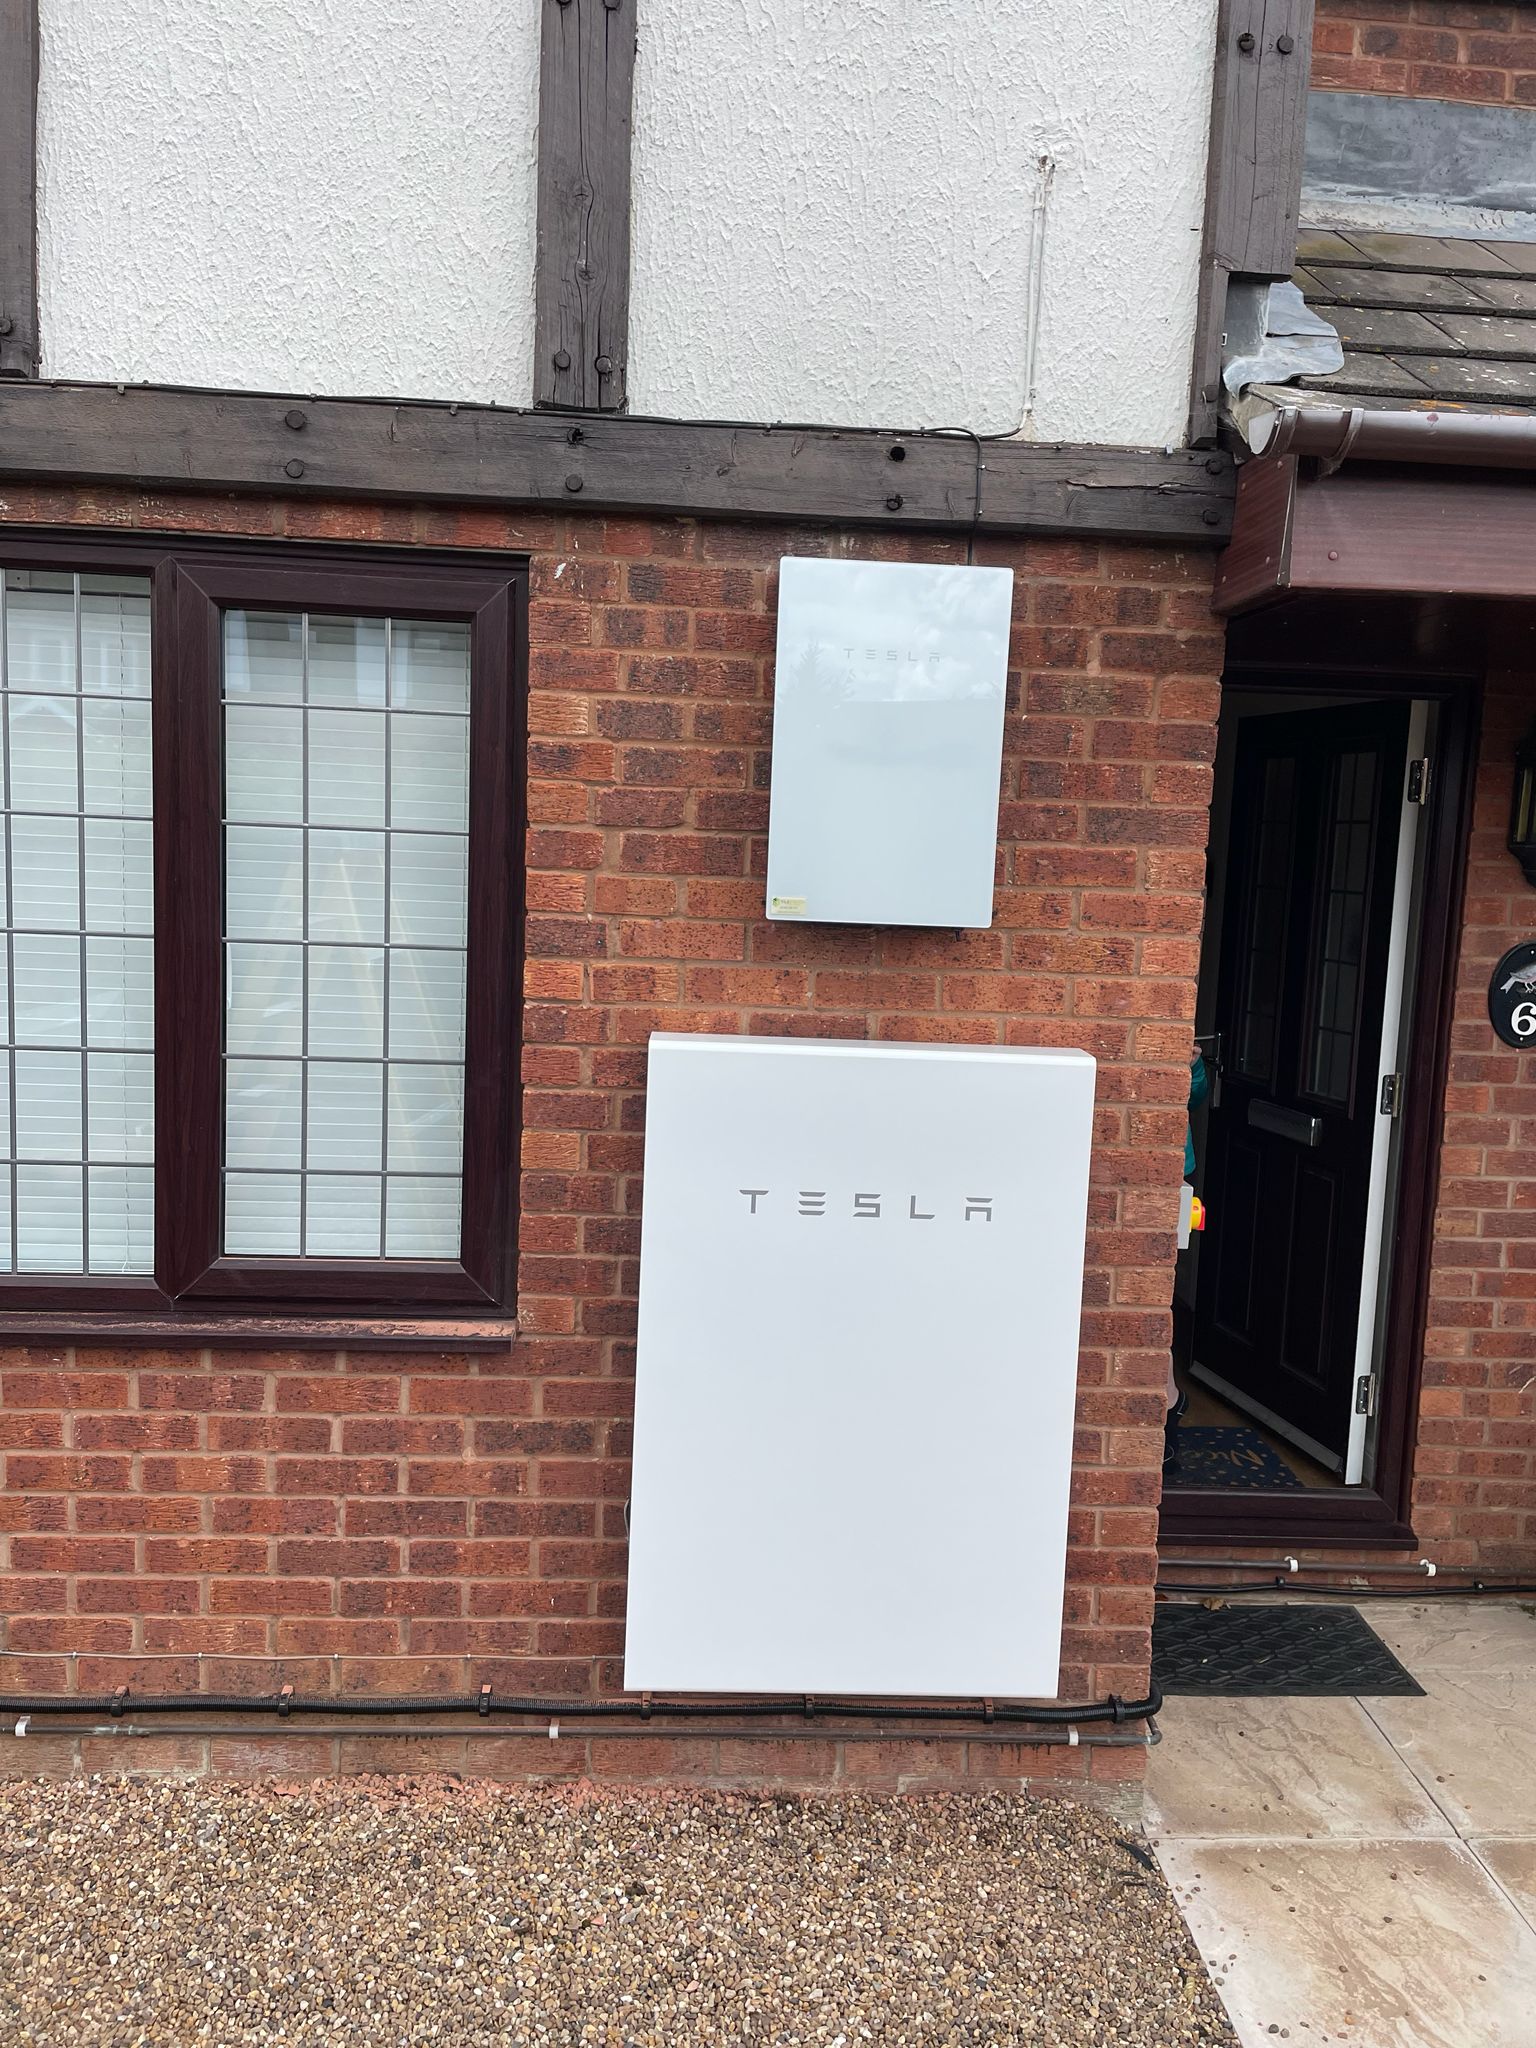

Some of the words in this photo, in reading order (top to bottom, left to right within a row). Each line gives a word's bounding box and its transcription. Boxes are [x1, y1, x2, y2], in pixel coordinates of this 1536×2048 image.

[843, 648, 941, 663] TESLA
[1511, 1002, 1536, 1036] 6
[739, 1189, 993, 1222] TESLA
